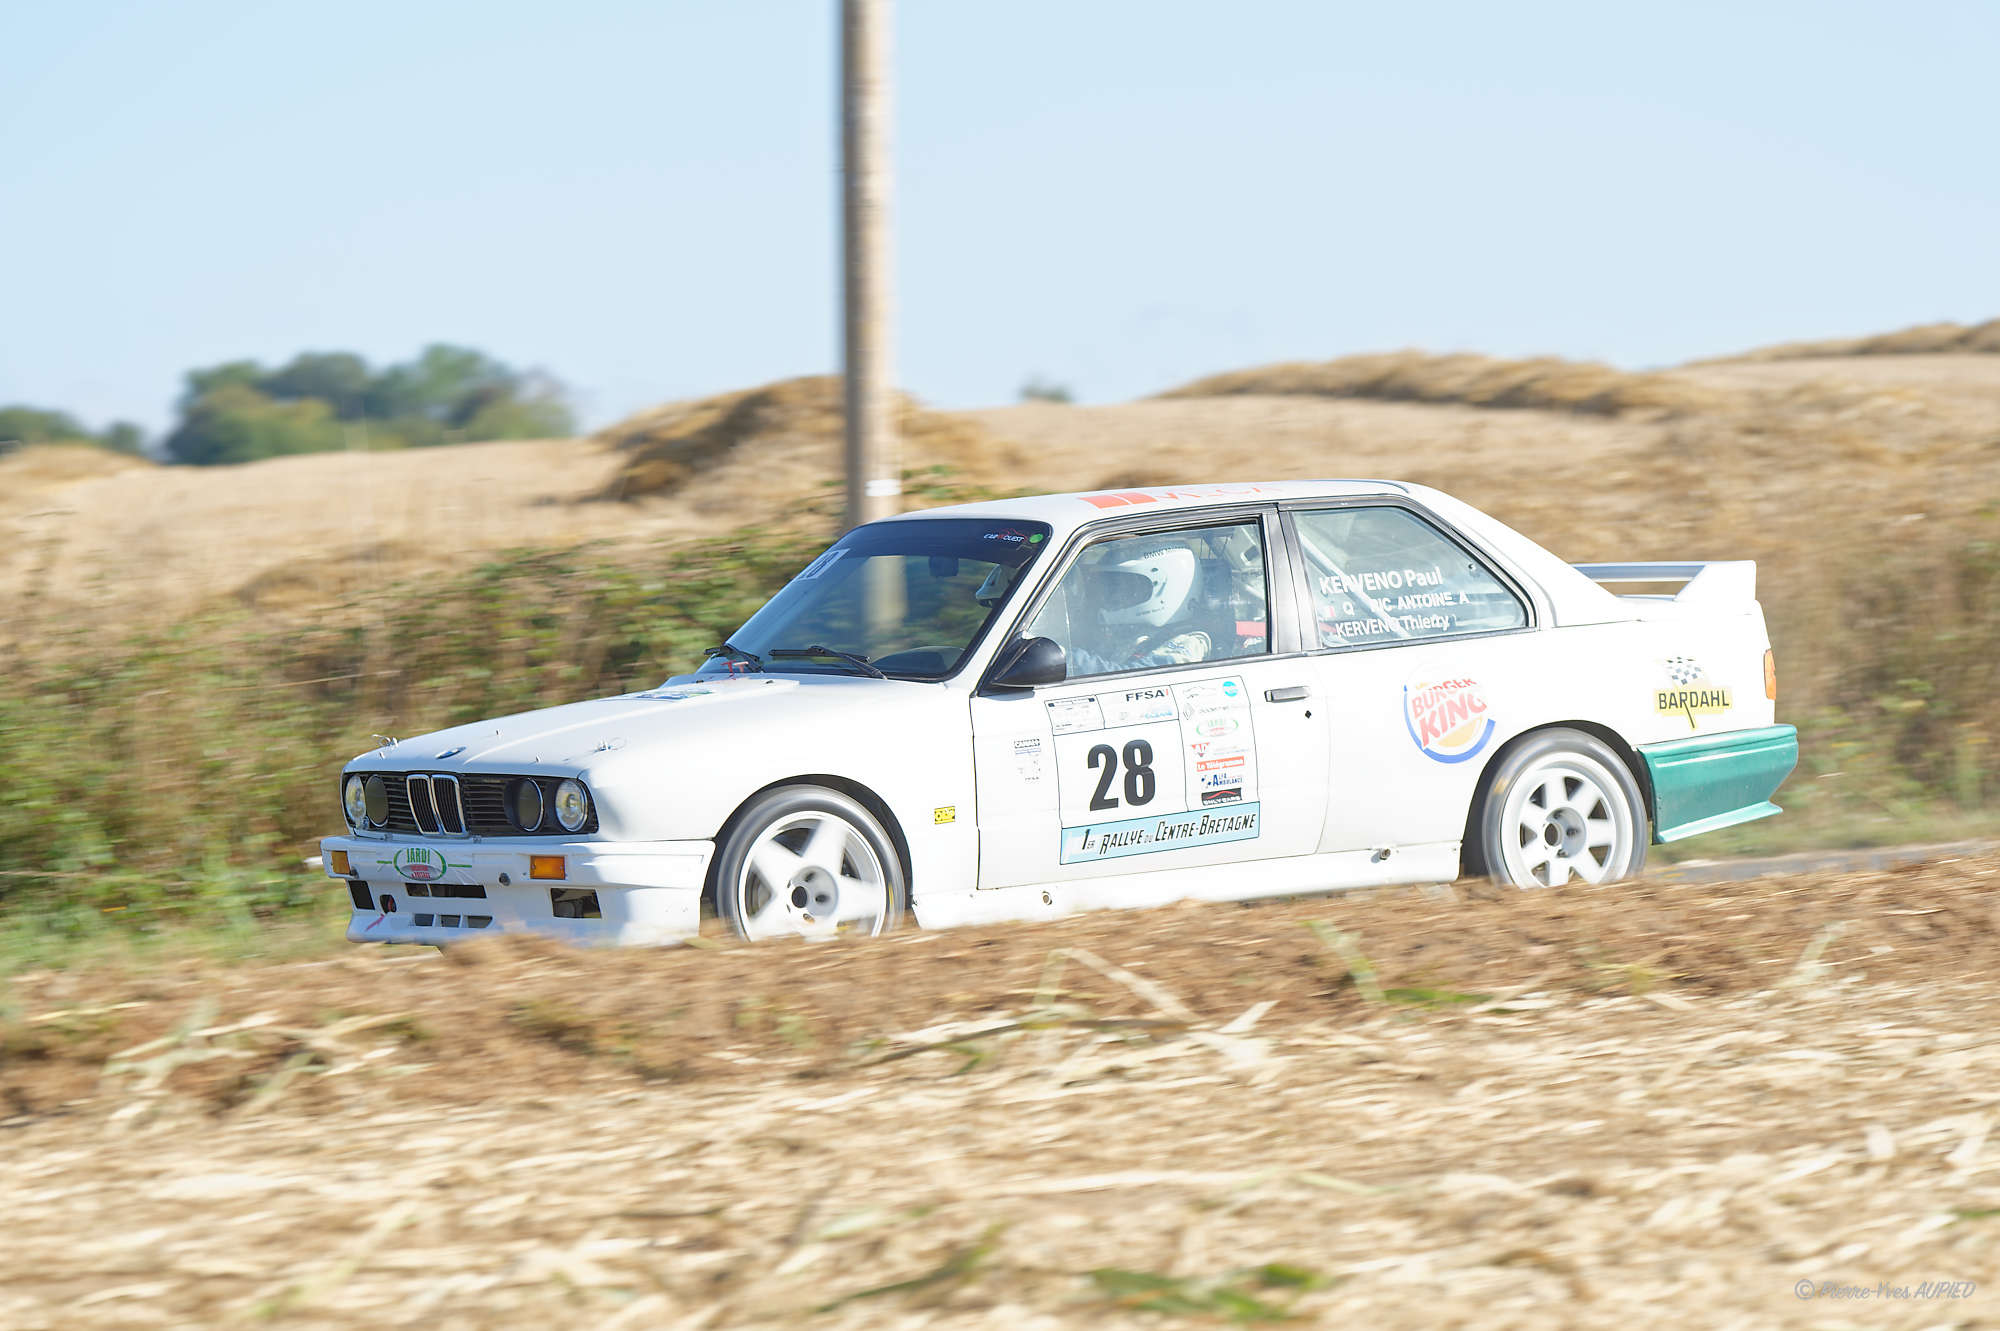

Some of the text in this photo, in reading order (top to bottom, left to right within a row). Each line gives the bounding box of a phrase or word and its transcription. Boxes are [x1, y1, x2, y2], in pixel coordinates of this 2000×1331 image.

[1319, 566, 1443, 595] KERVENO Paul
[1336, 614, 1450, 637] KERVENO Thierry
[1125, 689, 1165, 702] FFSA
[1411, 678, 1478, 720] BURGER
[1658, 690, 1730, 728] BARDAHL
[1419, 693, 1488, 747] KING
[1087, 739, 1156, 812] 28
[1099, 829, 1145, 855] RALLYE
[1155, 813, 1257, 842] CENTRE-BRETAGNE
